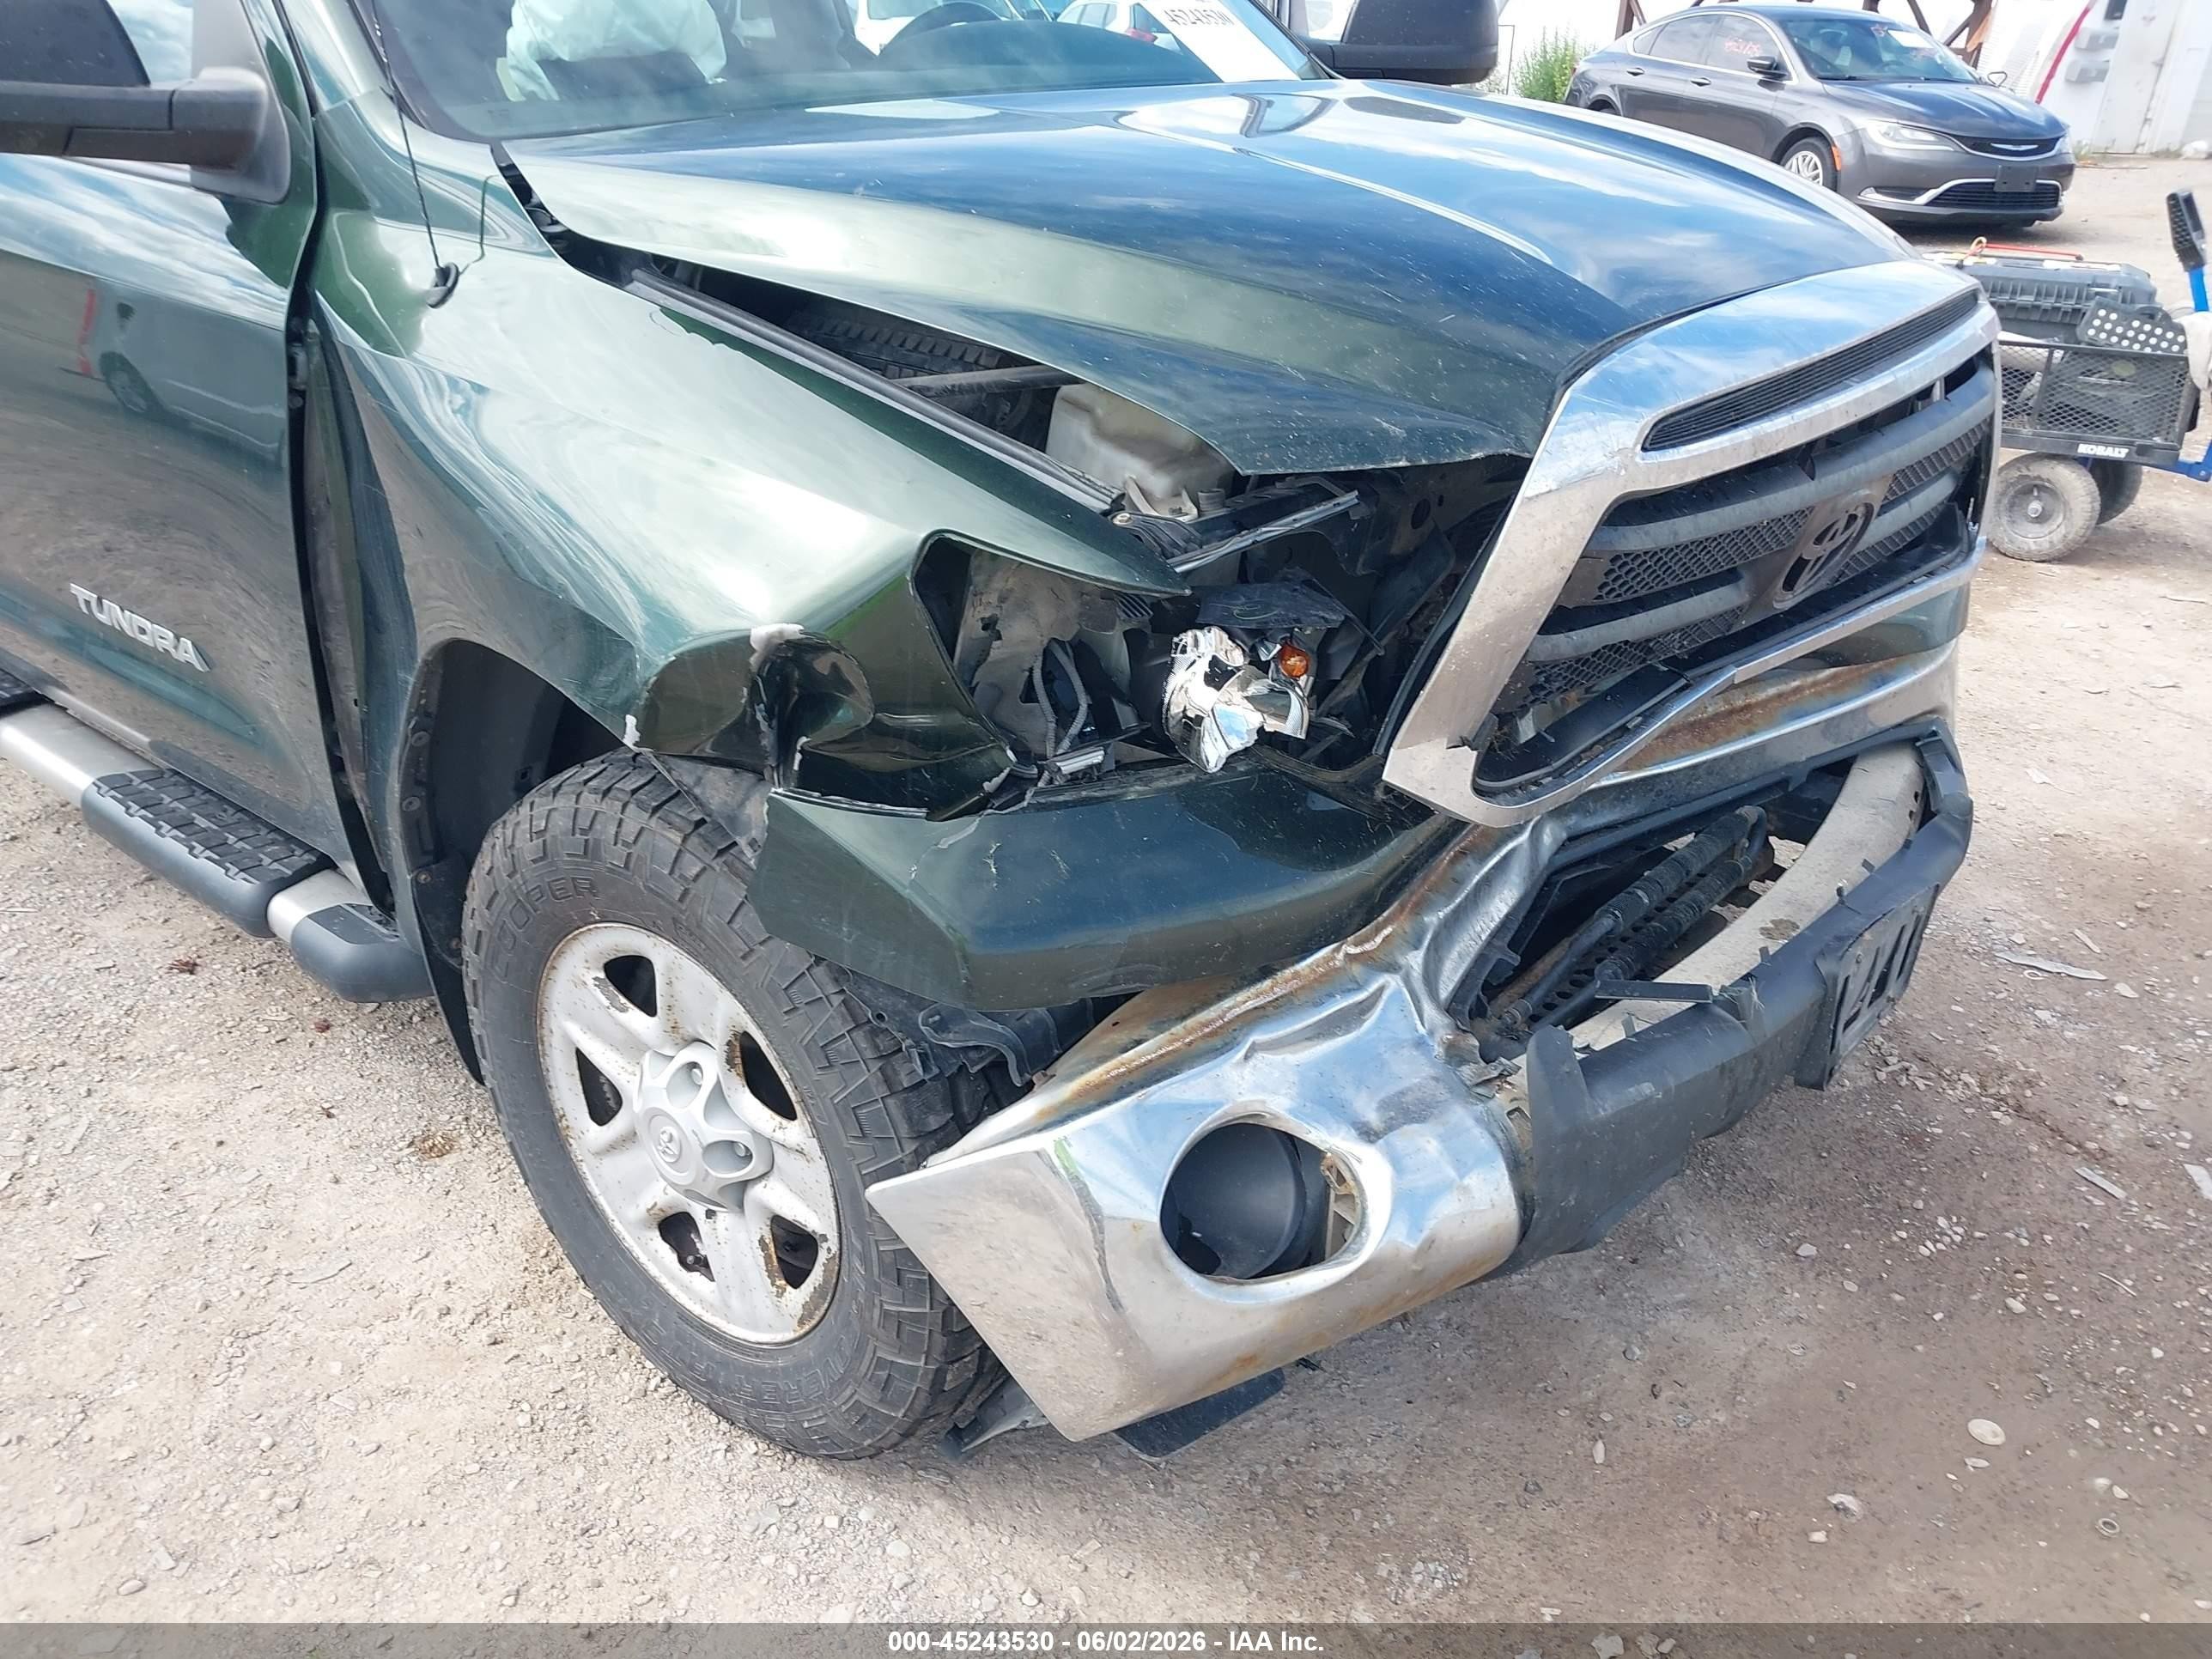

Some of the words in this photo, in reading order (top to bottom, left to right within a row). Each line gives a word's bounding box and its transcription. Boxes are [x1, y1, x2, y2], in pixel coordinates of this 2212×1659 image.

[1164, 9, 1235, 26] 45243530
[2078, 443, 2130, 459] KOBALT
[70, 583, 210, 672] TUNDRA
